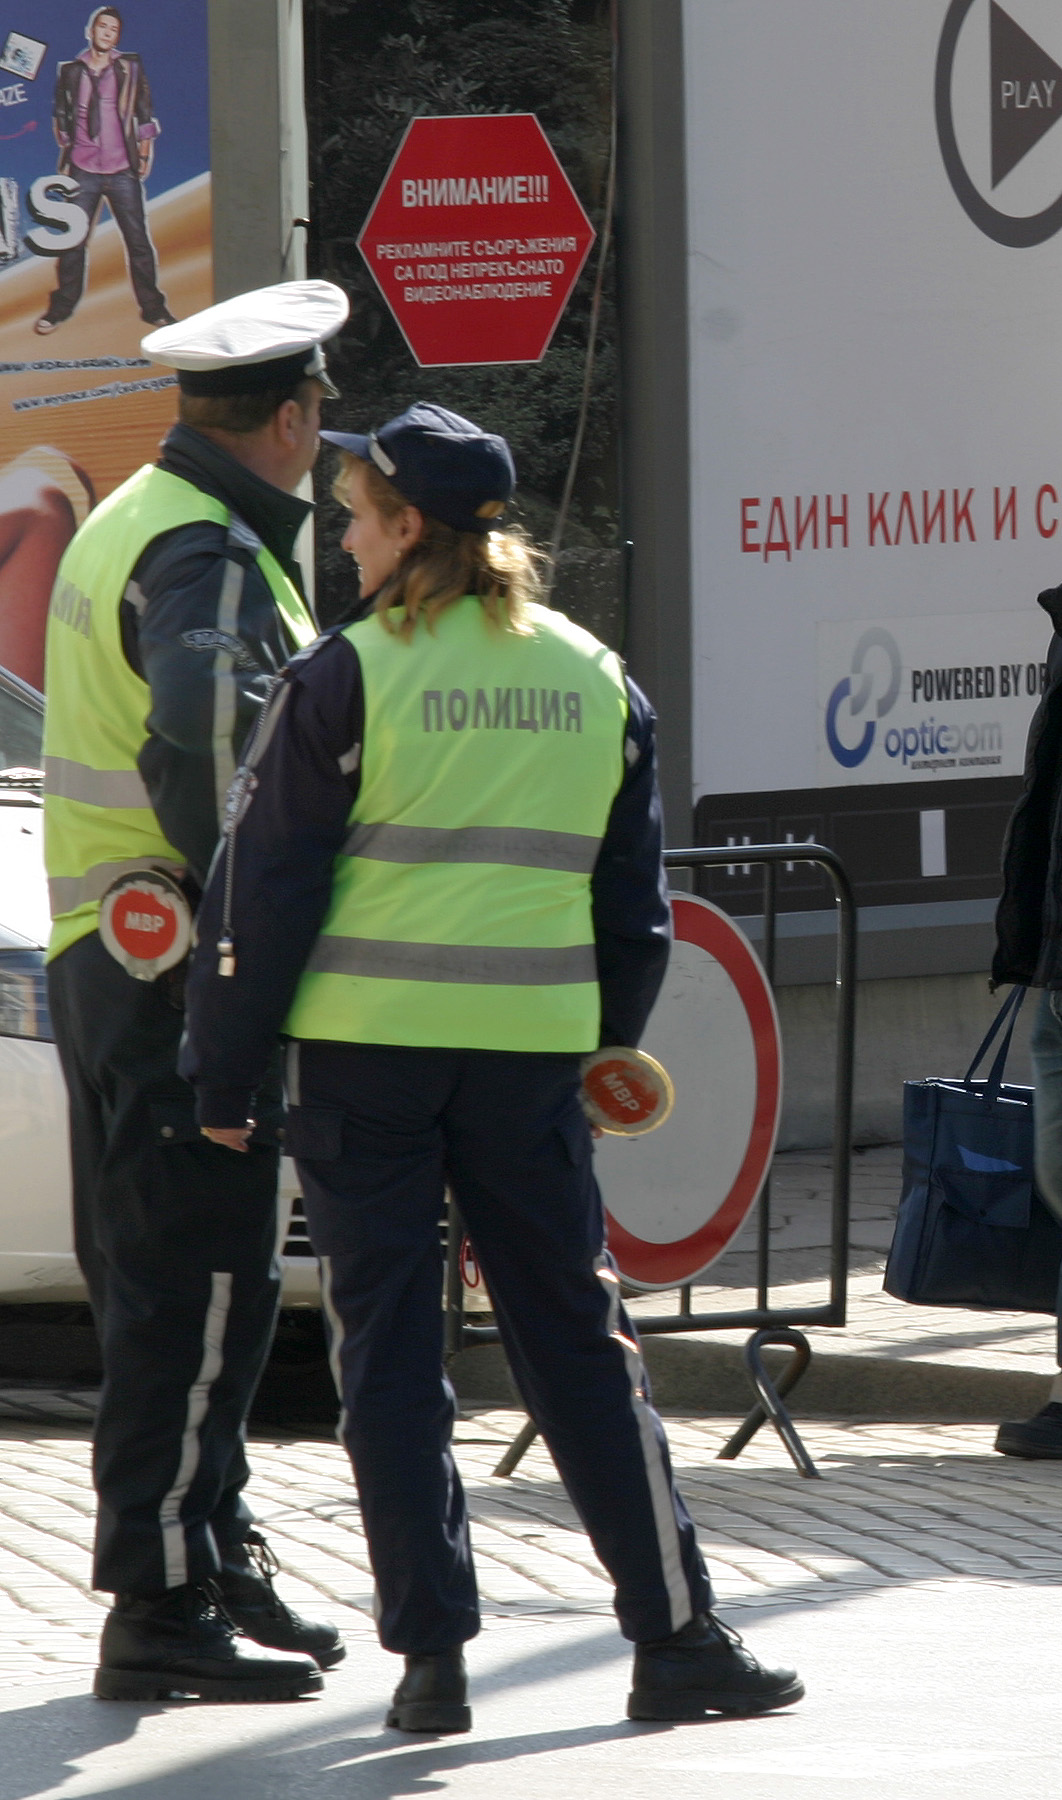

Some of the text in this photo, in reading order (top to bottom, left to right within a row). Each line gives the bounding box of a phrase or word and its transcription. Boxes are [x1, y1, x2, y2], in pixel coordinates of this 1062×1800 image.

[1001, 79, 1056, 109] PLAY
[402, 175, 549, 207] ВНИМАНИЕ!!!
[376, 237, 577, 259] РЕКЛАМНИТЕ СЪОРЪЖЕНИЯ
[394, 259, 565, 281] СА ПОД НЕПРЕКЪСНАТО
[404, 281, 552, 304] ВИДЕОНАБЛЮДЕНИЕ
[740, 494, 849, 563] ЕДИН
[868, 487, 976, 546] КЛИК
[994, 486, 1017, 540] И
[911, 666, 994, 703] POWERED
[1000, 664, 1022, 698] BY
[422, 688, 582, 733] ПОЛИЦИЯ
